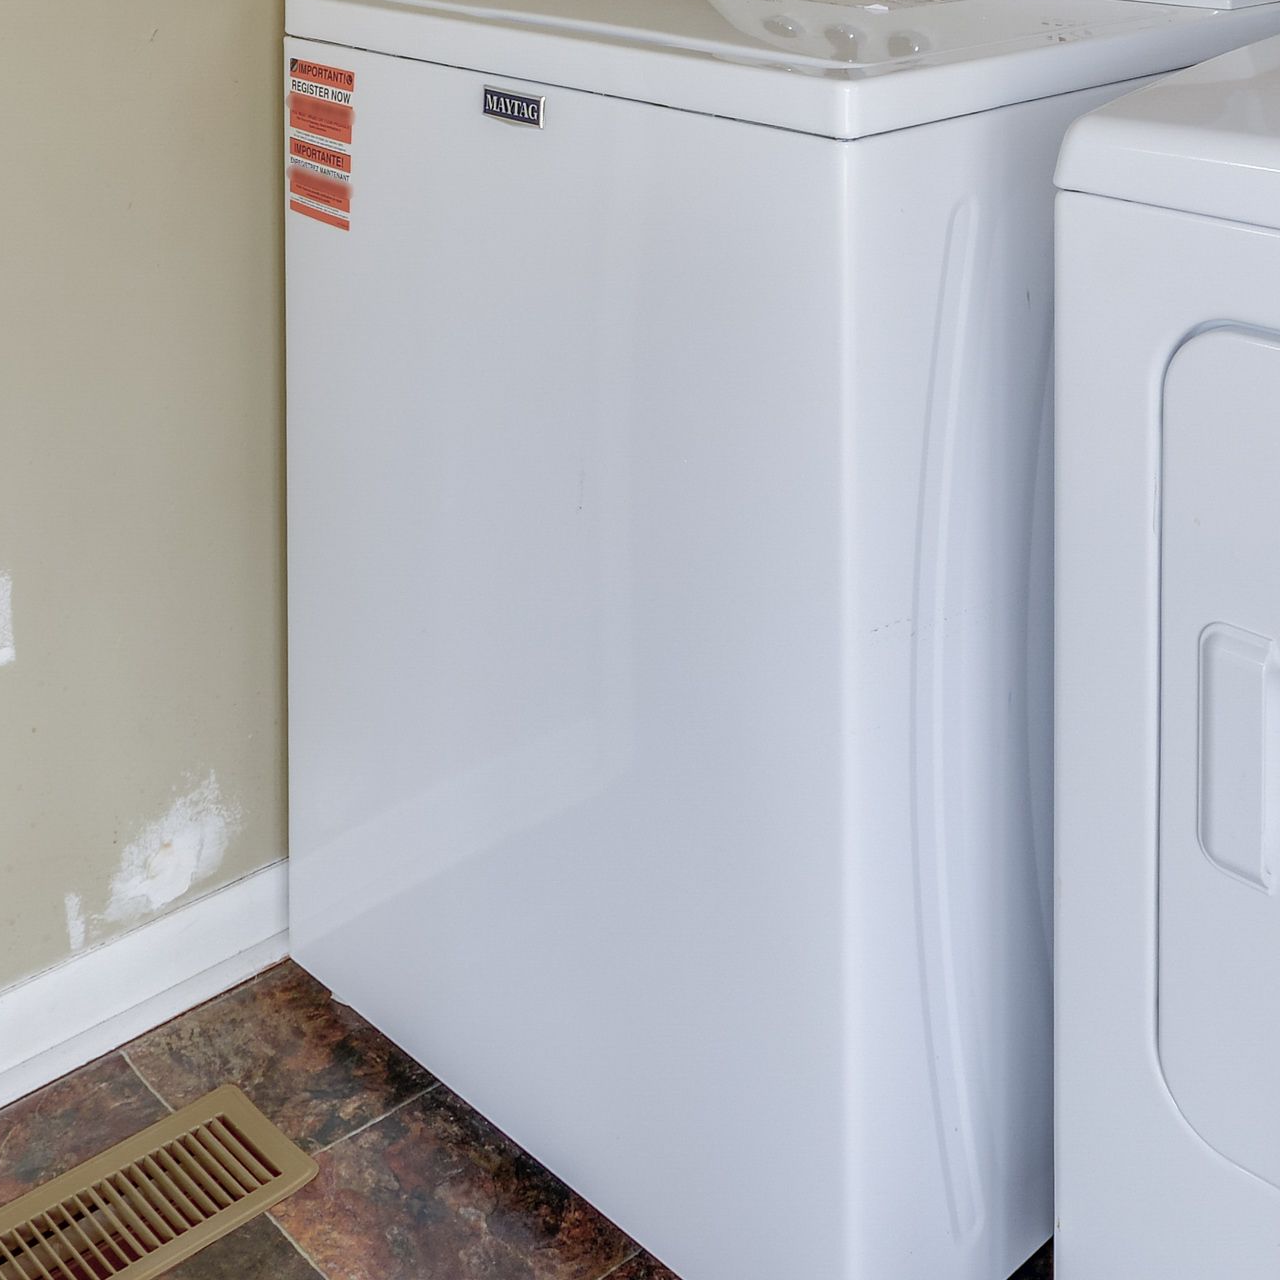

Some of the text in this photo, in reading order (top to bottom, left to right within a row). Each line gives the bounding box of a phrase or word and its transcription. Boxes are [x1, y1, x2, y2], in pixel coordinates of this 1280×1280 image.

[298, 62, 345, 84] IMPORTANT!
[291, 78, 350, 105] REGISTER NOW
[485, 93, 539, 121] MAYTAG
[293, 142, 343, 168] IMPORTANTE!
